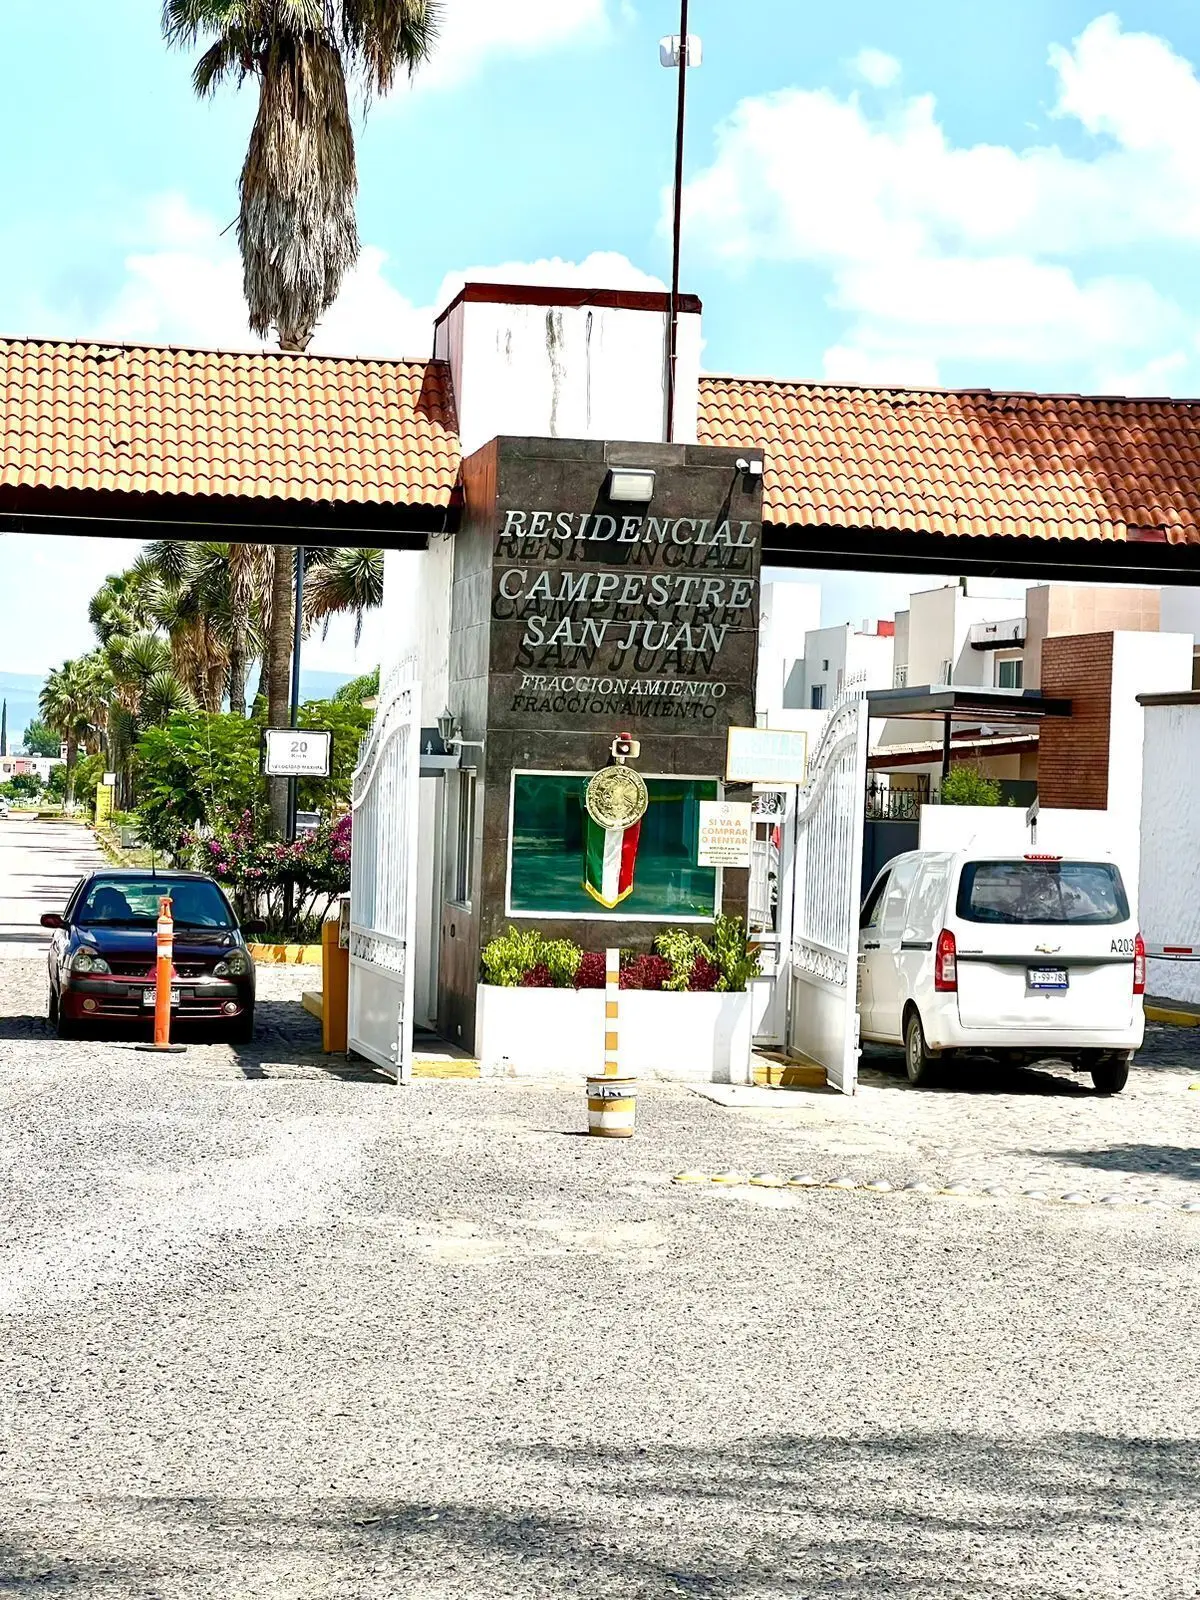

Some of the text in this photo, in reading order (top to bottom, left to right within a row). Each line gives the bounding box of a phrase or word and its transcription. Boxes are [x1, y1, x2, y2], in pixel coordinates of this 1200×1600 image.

[500, 510, 757, 548] RESIDENCIAL
[499, 569, 755, 609] CAMPESTRE
[522, 615, 730, 653] SAN JUAN
[519, 675, 727, 698] FRACCIONAMIENTO
[291, 741, 308, 753] 20
[709, 818, 717, 826] SI
[734, 819, 741, 827] A
[702, 828, 748, 836] COMPRAR
[711, 837, 748, 845] RENTAR
[1110, 938, 1135, 953] A203
